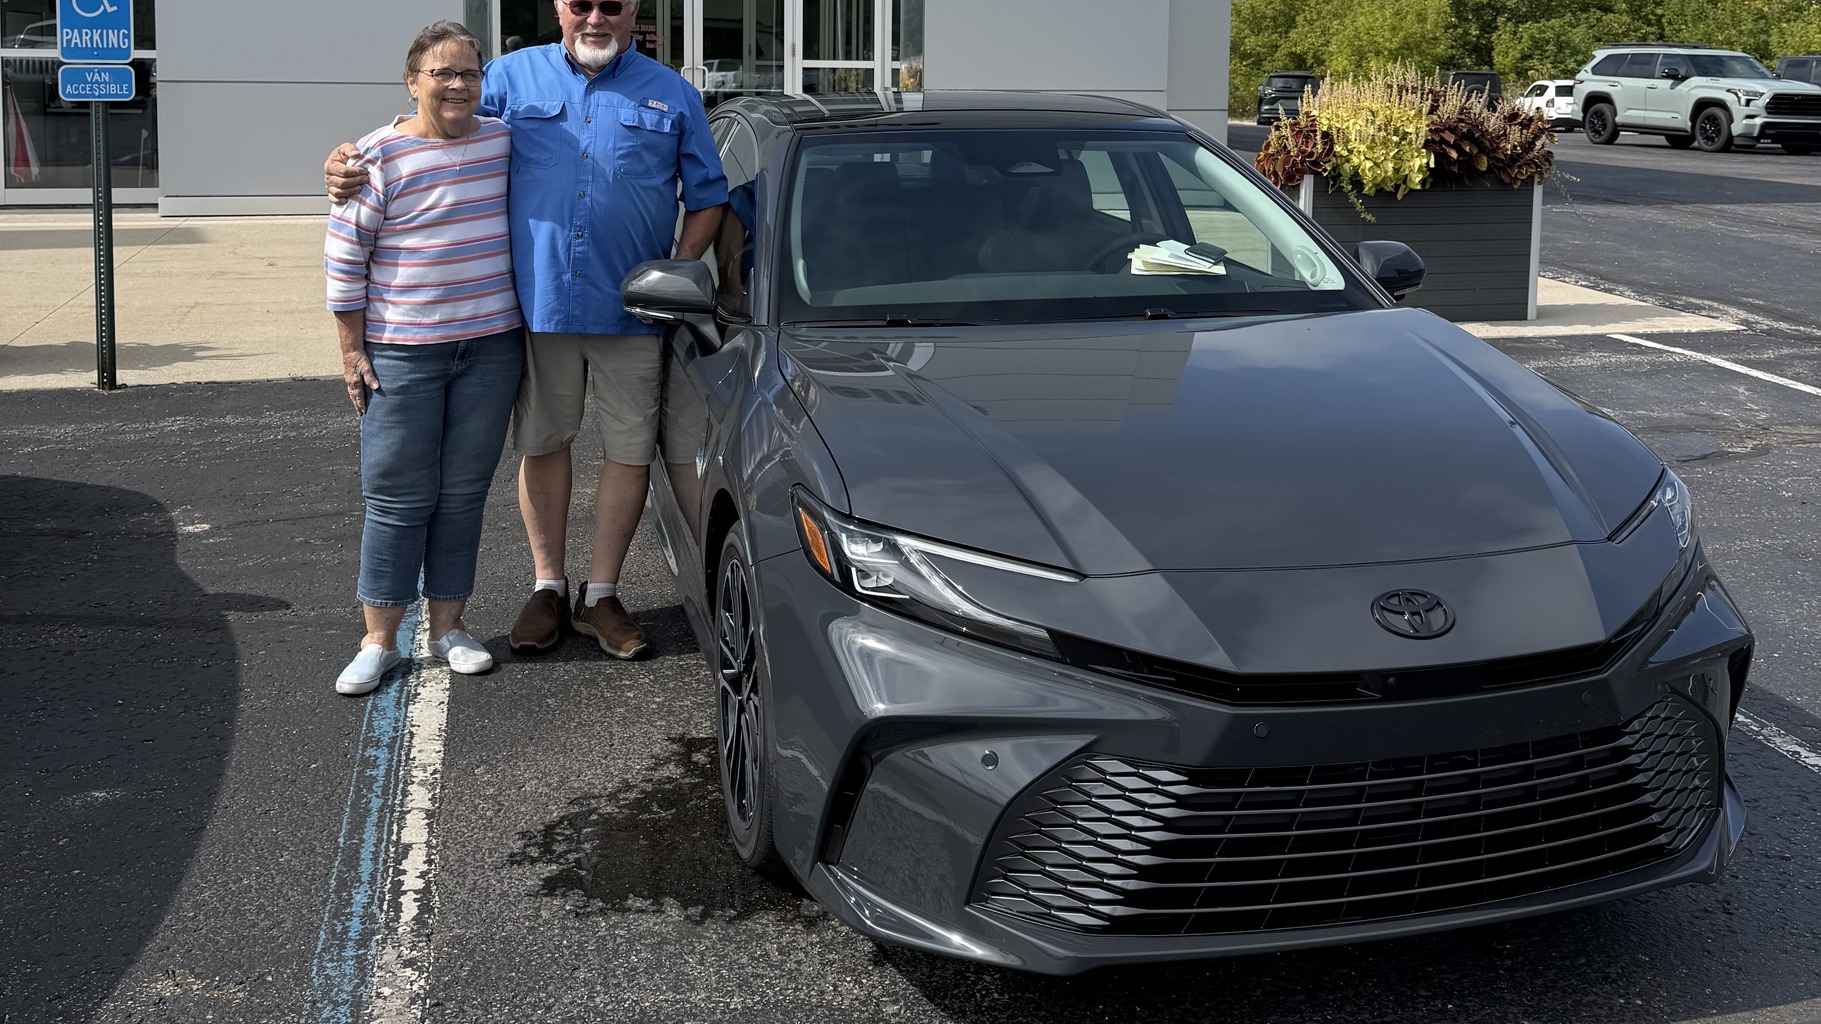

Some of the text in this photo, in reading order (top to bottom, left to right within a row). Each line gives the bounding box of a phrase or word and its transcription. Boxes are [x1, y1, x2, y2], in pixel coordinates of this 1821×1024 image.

[62, 28, 129, 49] PARKING
[85, 71, 109, 82] VAN
[65, 83, 129, 95] ACCESSIBLE
